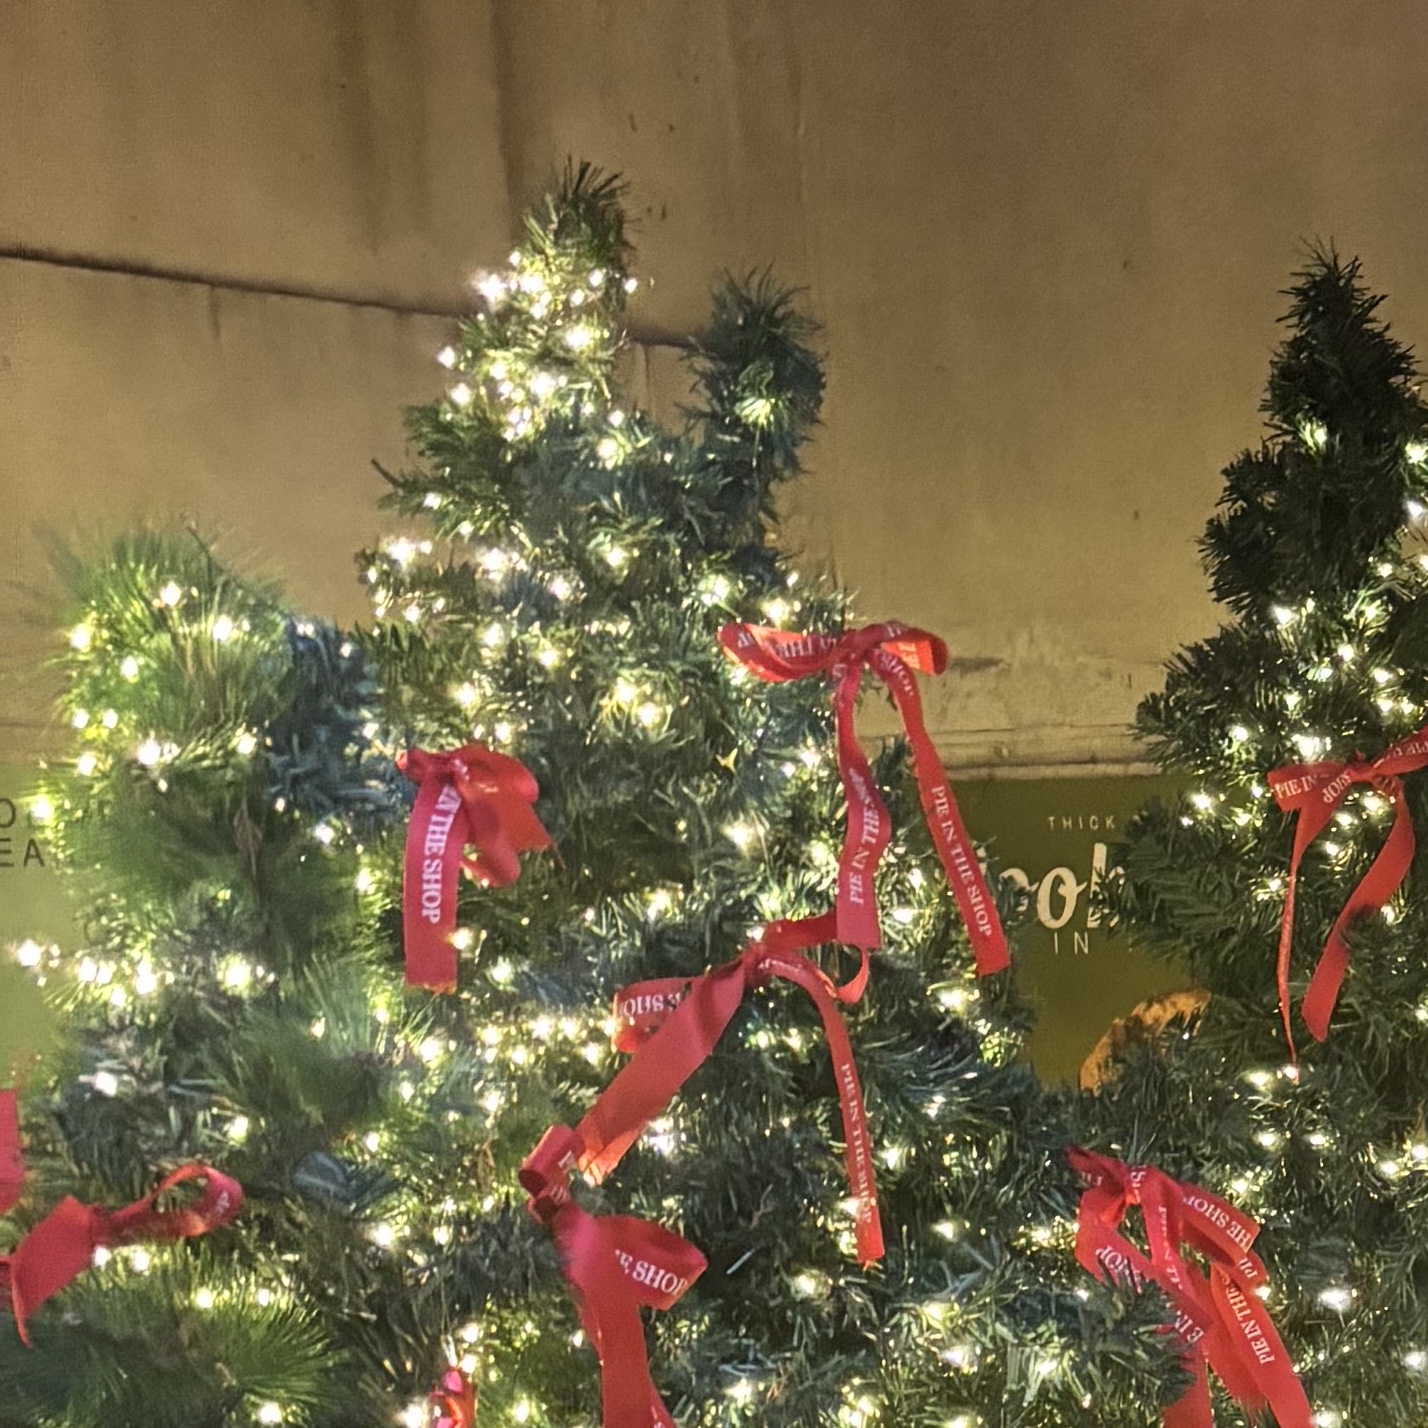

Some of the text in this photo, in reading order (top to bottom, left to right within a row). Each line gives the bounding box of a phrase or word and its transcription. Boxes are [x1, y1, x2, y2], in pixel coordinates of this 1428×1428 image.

[1048, 815, 1116, 830] THICK
[421, 857, 442, 924] SHOP
[952, 844, 992, 937] THE SHOP
[1053, 932, 1089, 954] IN
[1251, 1336, 1274, 1364] PIE
